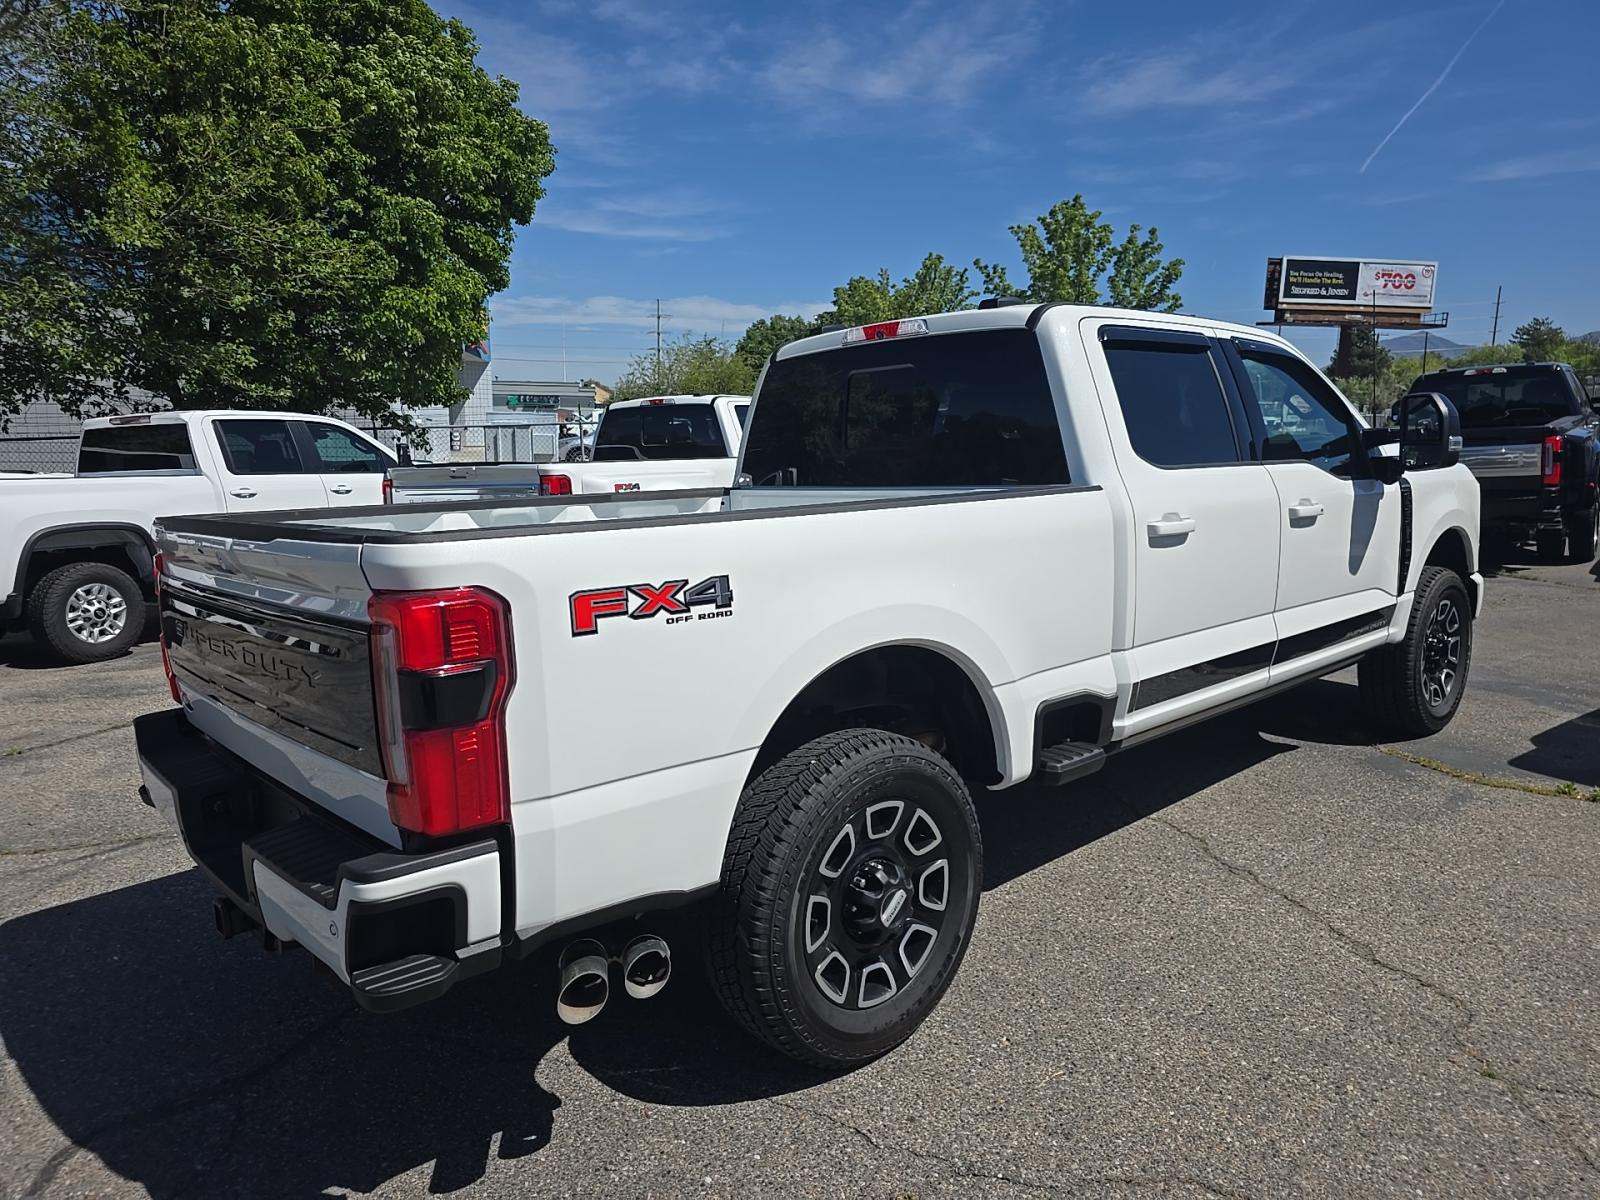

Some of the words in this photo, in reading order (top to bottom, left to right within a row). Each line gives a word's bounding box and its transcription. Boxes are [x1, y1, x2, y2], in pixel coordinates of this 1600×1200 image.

[1374, 272, 1416, 289] $700
[1320, 287, 1326, 295] &
[1326, 287, 1349, 296] JENSEN
[569, 574, 733, 638] FX4
[666, 616, 694, 625] OFF
[698, 610, 733, 621] ROAD
[242, 646, 322, 688] DUTY
